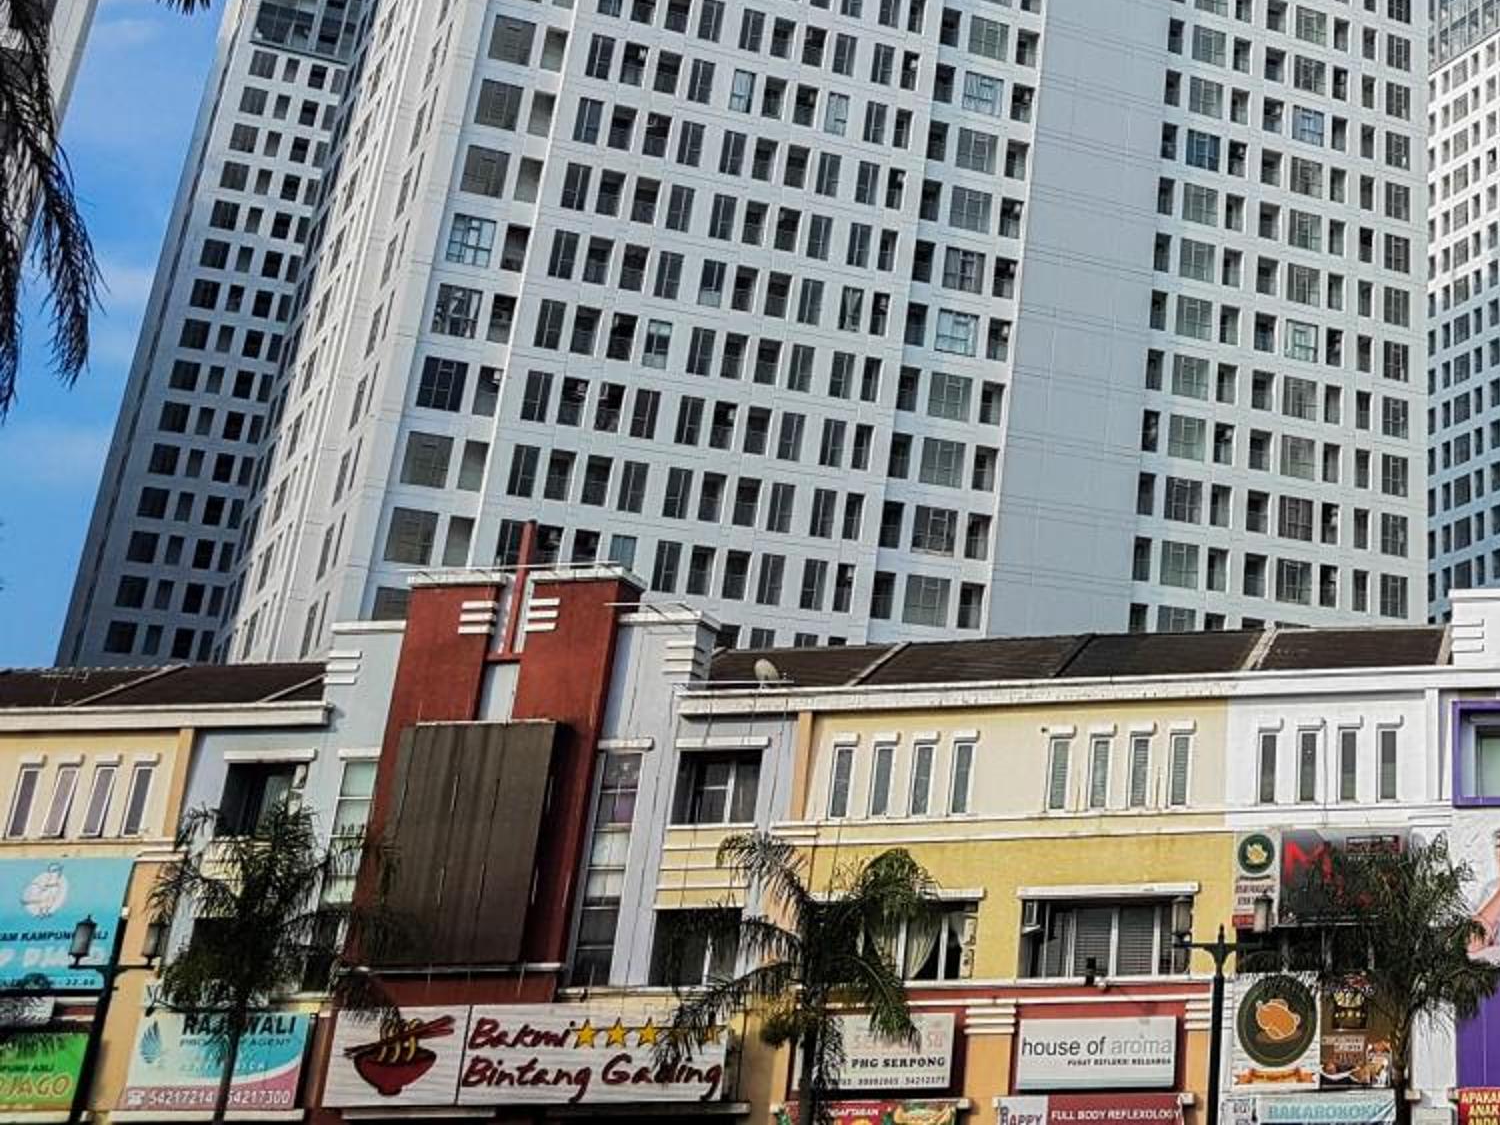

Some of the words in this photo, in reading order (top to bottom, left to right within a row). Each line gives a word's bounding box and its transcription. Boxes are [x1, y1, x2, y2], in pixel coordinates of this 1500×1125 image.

[21, 930, 77, 941] KAMPUN
[468, 1017, 576, 1050] Bakmi
[1021, 1037, 1081, 1057] house
[1087, 1036, 1107, 1056] of
[1111, 1036, 1173, 1056] aroma
[882, 1056, 946, 1068] SERPONG
[461, 1056, 592, 1104] Bintang
[601, 1053, 723, 1101] Gading
[1051, 1110, 1074, 1121] FULL
[1077, 1110, 1107, 1121] BODY
[1108, 1108, 1181, 1120] REFLEXOLOGY
[1468, 1105, 1500, 1116] ANAK
